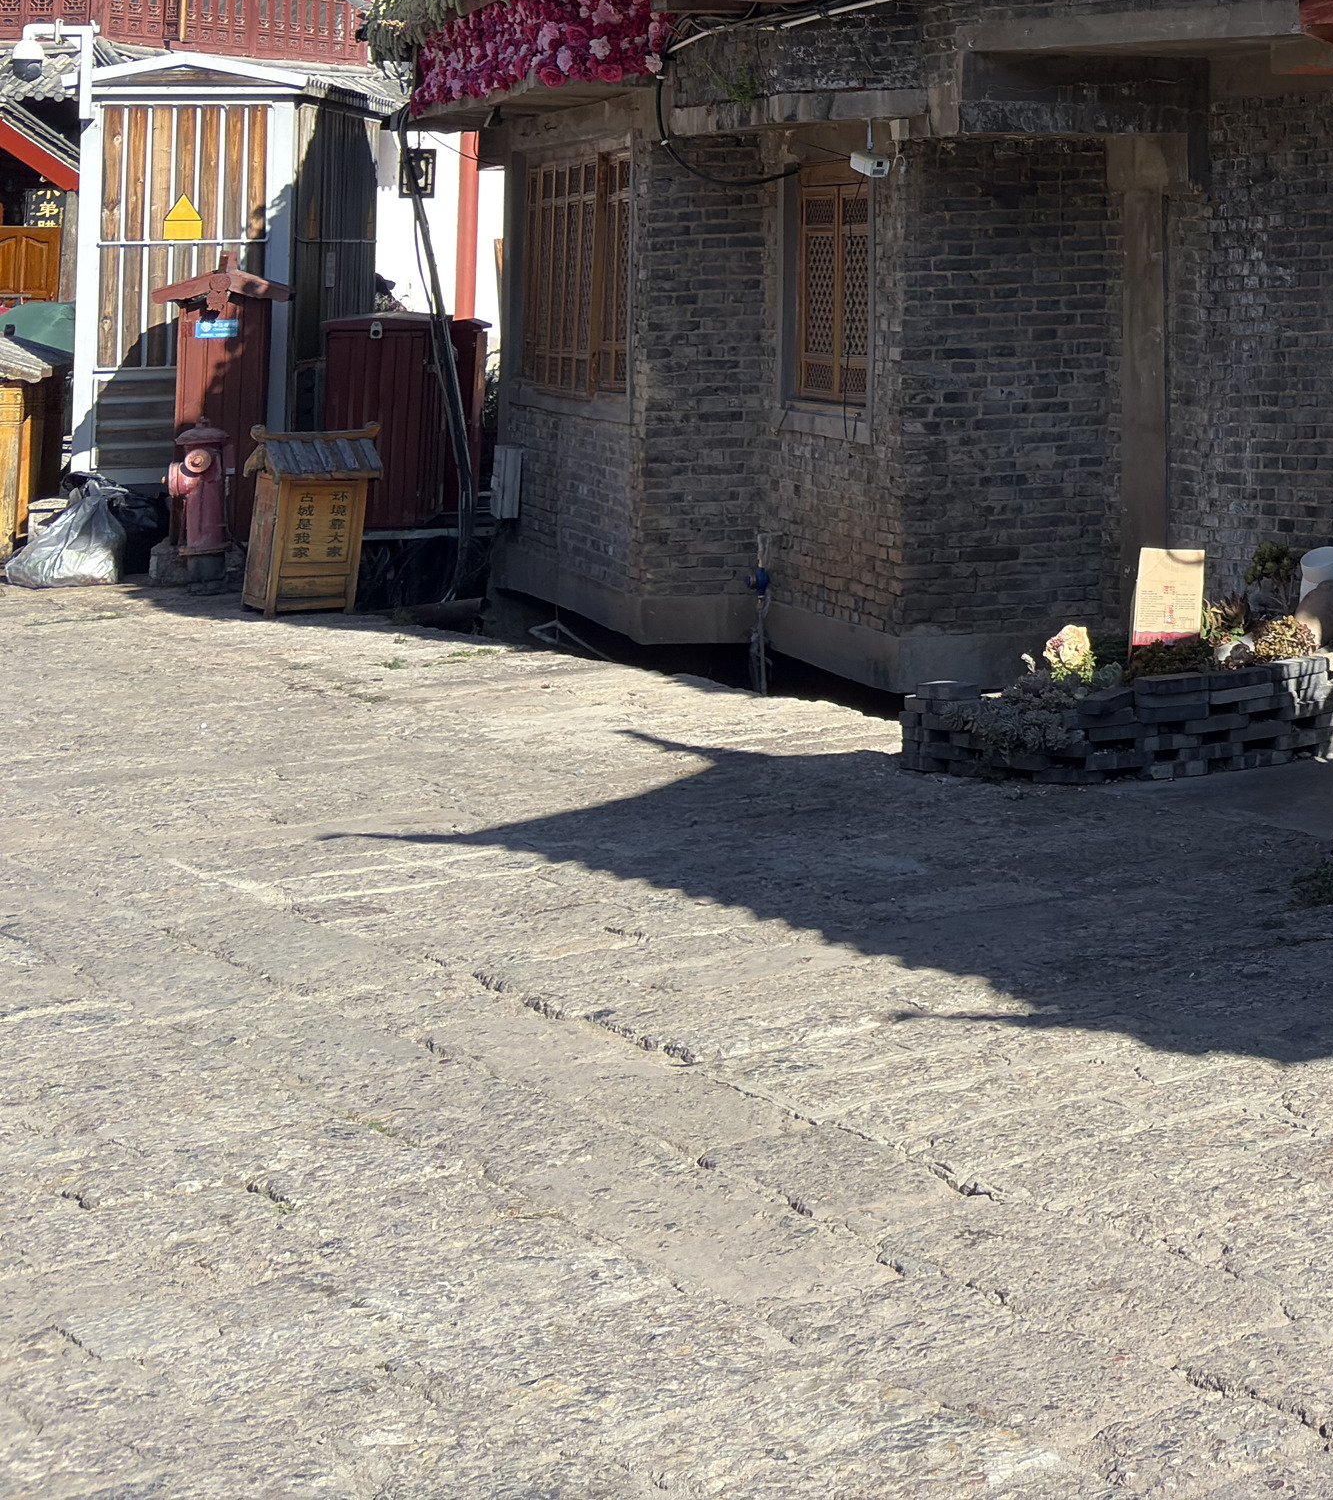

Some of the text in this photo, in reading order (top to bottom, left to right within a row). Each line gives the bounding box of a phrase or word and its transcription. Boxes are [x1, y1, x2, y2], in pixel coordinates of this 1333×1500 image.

[292, 492, 315, 558] 古城是我家
[325, 492, 348, 557] 环境靠大家
